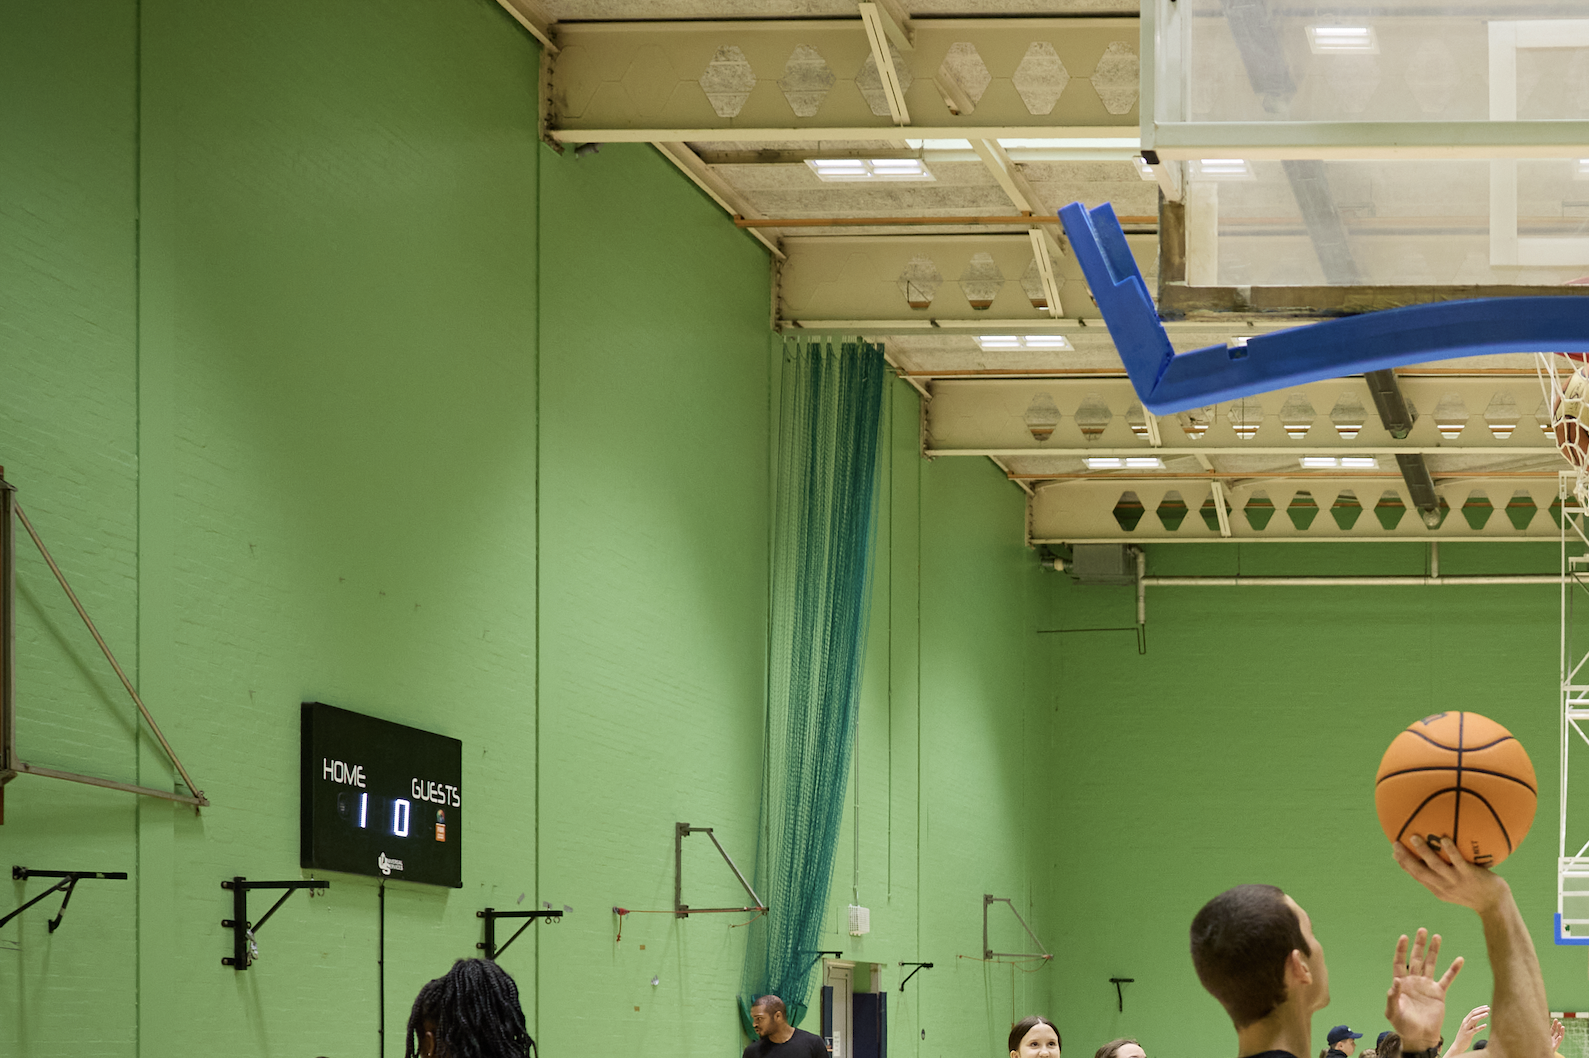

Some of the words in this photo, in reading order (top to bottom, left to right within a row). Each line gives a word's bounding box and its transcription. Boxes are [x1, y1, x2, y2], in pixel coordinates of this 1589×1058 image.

[323, 757, 366, 788] HOME
[411, 777, 460, 808] GUESTS
[360, 792, 368, 829] 1
[393, 798, 410, 837] 0
